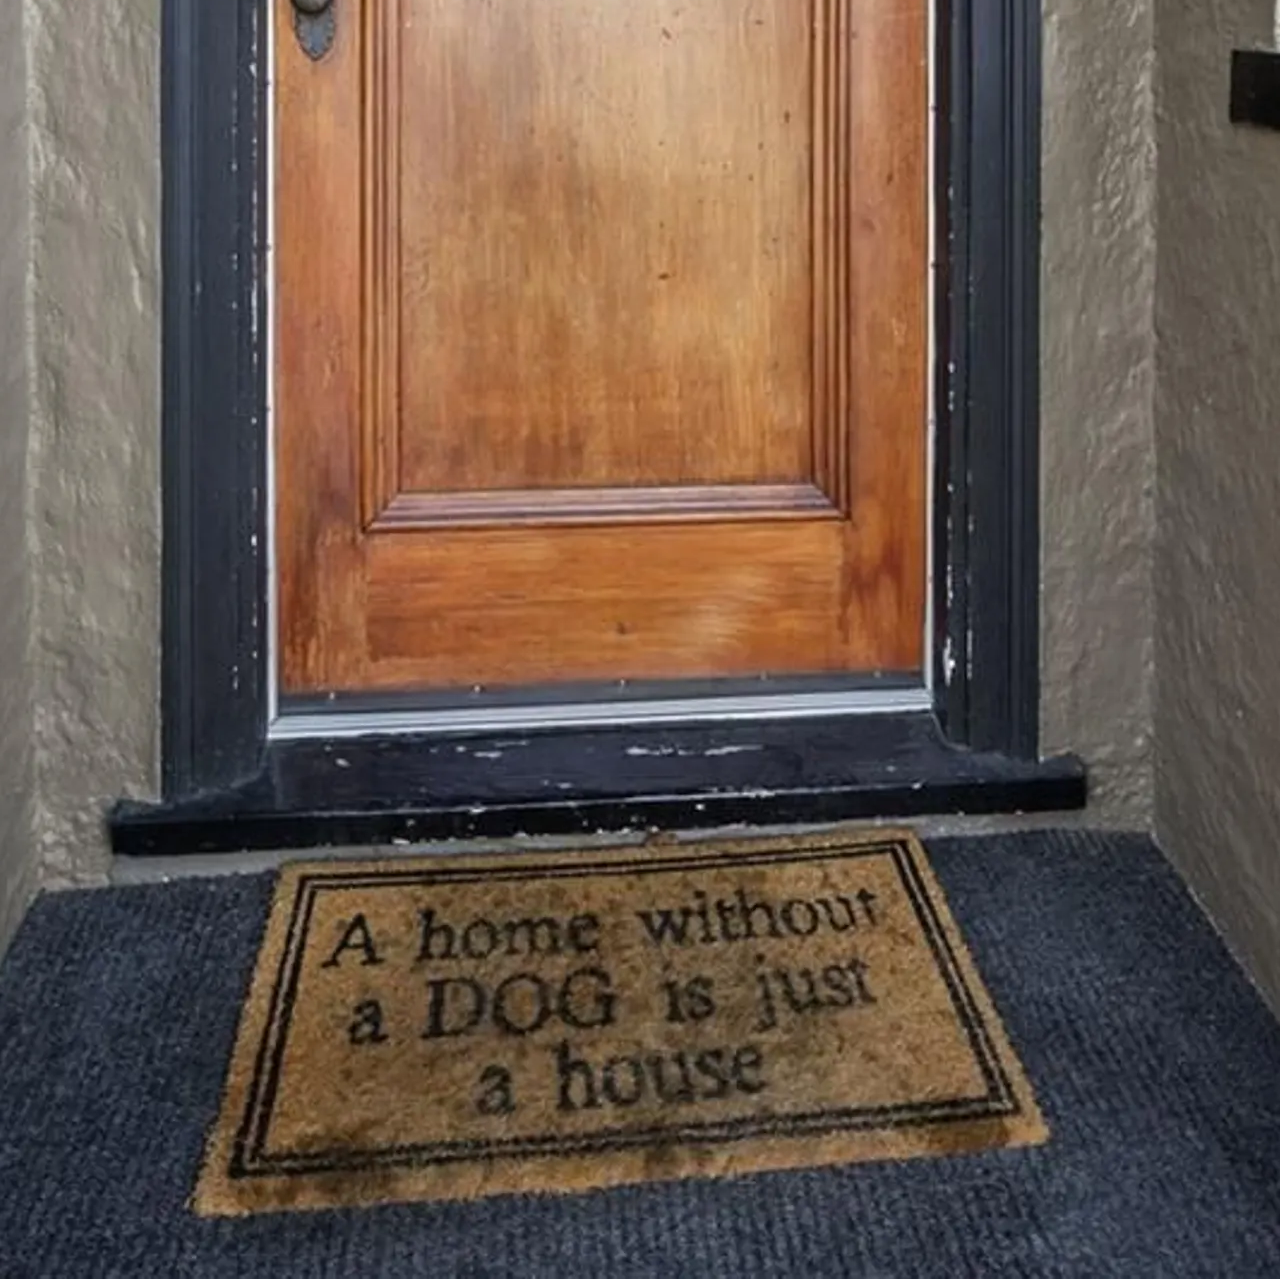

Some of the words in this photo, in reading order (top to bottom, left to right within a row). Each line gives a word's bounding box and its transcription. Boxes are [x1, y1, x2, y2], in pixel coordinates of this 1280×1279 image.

[321, 912, 385, 967] A
[414, 908, 600, 961] home
[634, 887, 876, 947] without
[348, 998, 389, 1045] a
[421, 967, 617, 1040] DOG
[661, 961, 716, 1023] is
[754, 953, 877, 1034] just
[475, 1064, 516, 1115] a
[555, 1038, 767, 1112] house
